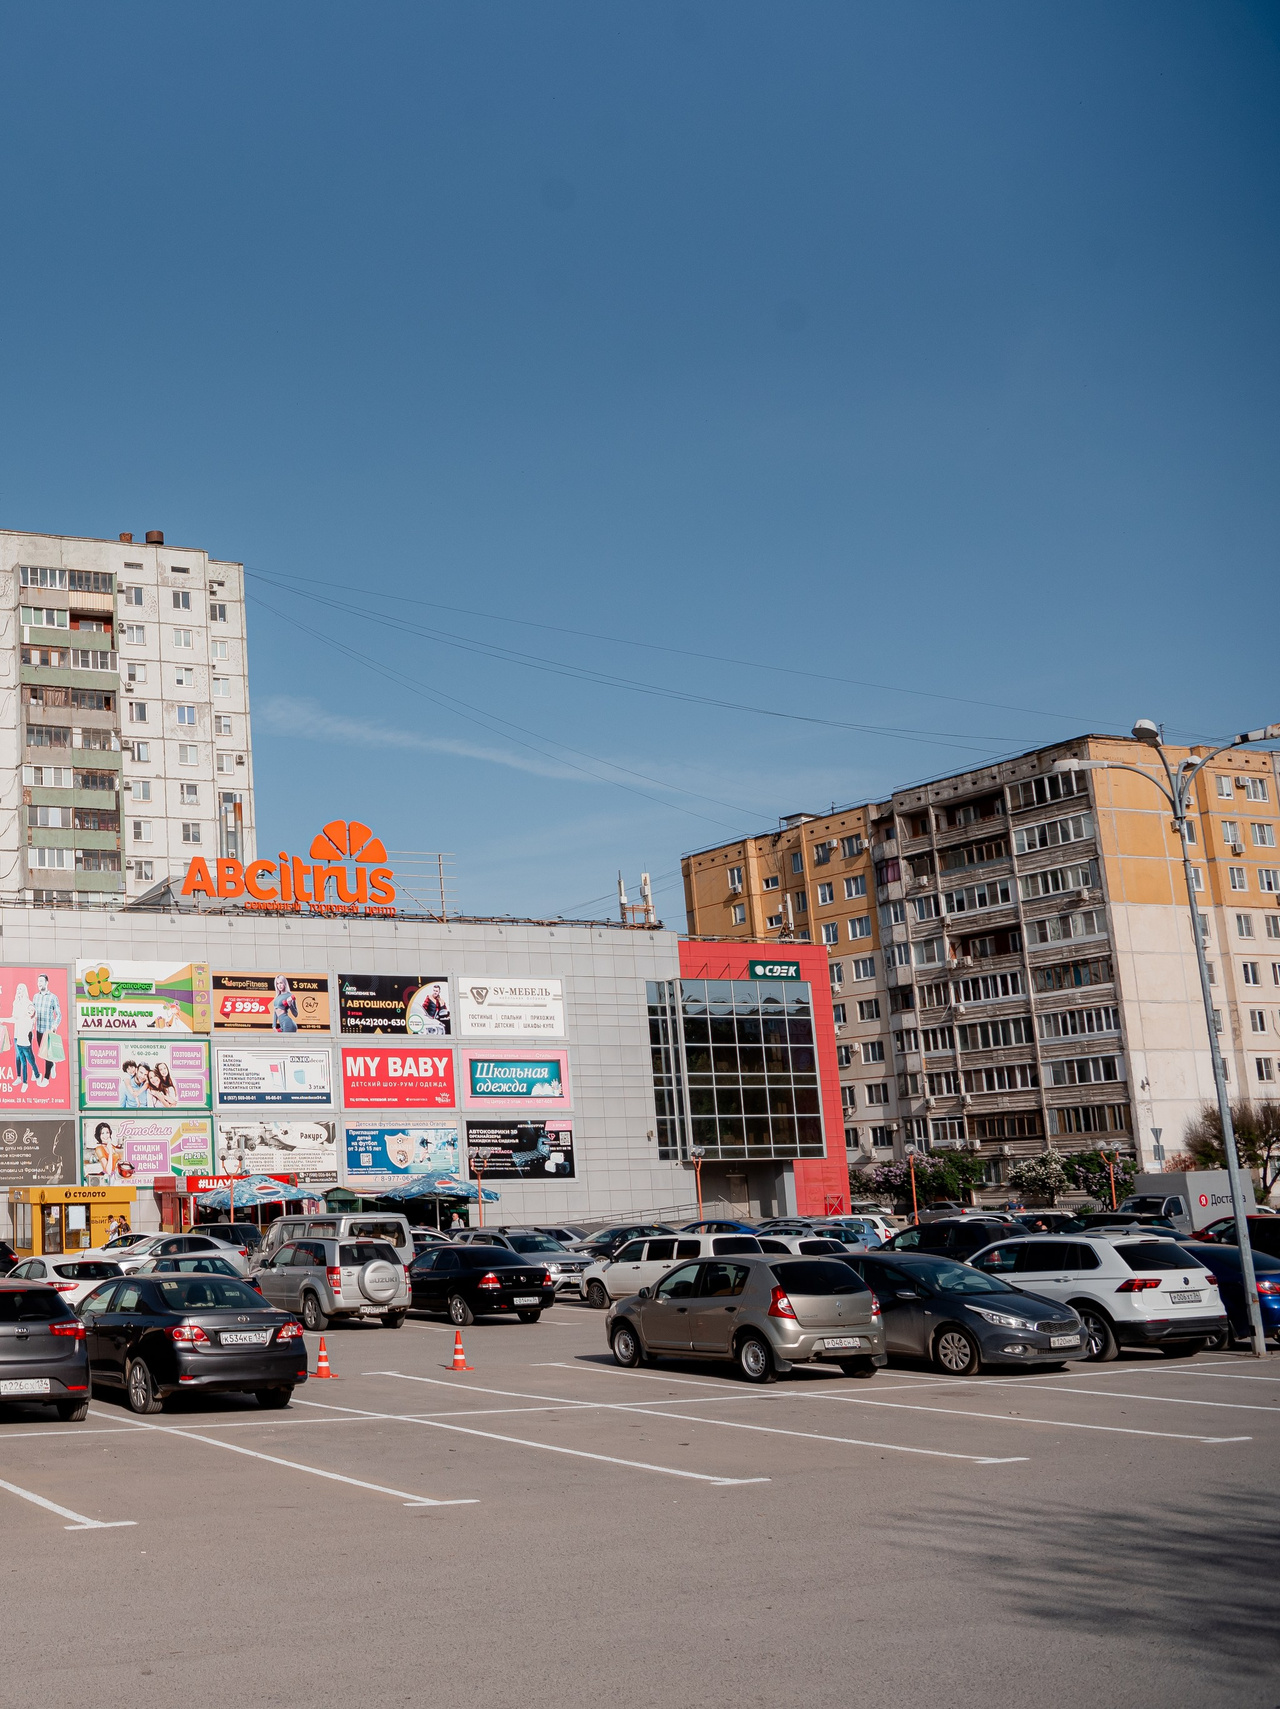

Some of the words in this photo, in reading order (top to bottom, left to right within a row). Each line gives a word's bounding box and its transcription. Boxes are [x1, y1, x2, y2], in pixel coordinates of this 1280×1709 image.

[181, 852, 396, 904] ABCitrus
[245, 900, 301, 911] семейный
[309, 902, 359, 914] торговый
[364, 906, 397, 916] центр
[764, 965, 796, 977] CDEK
[346, 1000, 405, 1009] АВТОШКОЛА
[81, 1007, 117, 1017] ЦЕНТР
[118, 1010, 153, 1018] ПОДАРКОВ
[82, 1019, 102, 1028] ДЛЯ
[105, 1019, 137, 1028] ДОМА
[347, 1018, 406, 1027] (8442)200-630
[346, 1057, 380, 1077] MY
[388, 1057, 448, 1077] BABY
[475, 1063, 548, 1078] Школьная
[476, 1079, 527, 1093] одежда
[116, 1120, 172, 1138] Готовим
[300, 1132, 323, 1141] Ракурс
[132, 1153, 163, 1161] каждый
